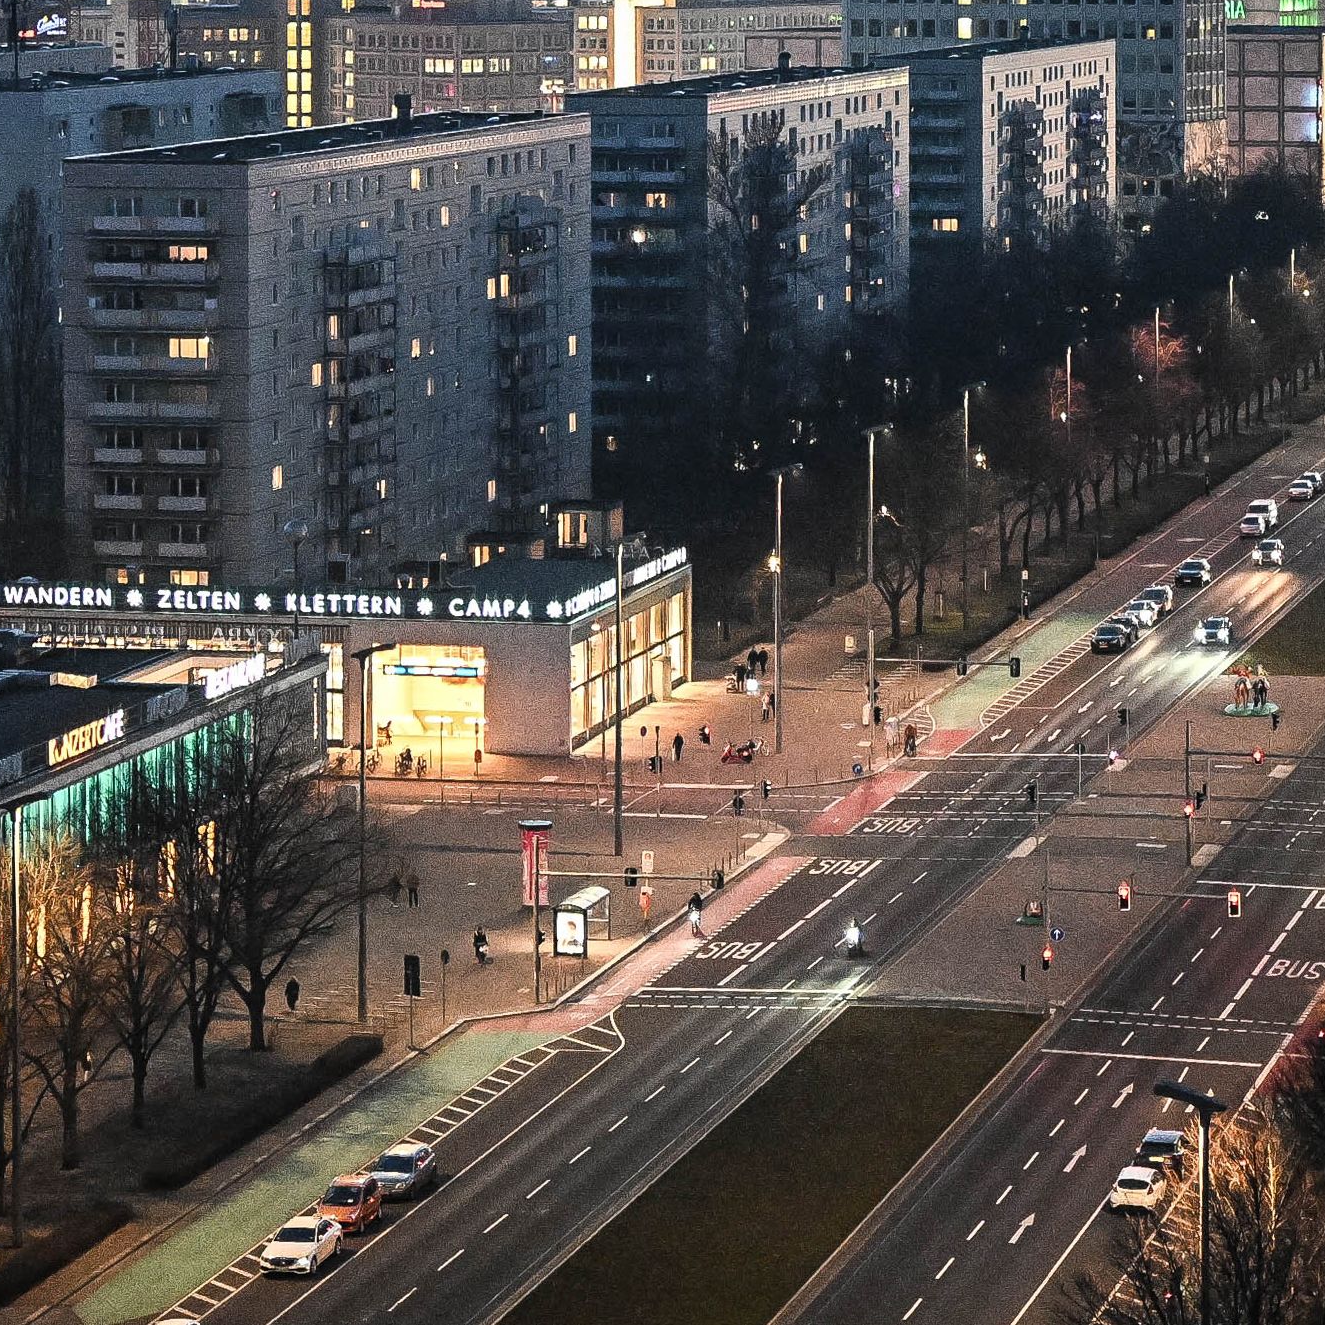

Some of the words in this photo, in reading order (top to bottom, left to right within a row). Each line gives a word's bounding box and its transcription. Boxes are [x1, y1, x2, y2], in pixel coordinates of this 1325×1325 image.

[4, 585, 112, 607] WANDERN
[157, 589, 240, 611] ZELTEN
[285, 592, 402, 616] KLETTERN
[448, 597, 531, 619] CAMP4
[862, 818, 919, 833] BUS
[809, 859, 870, 875] BUS
[695, 941, 764, 960] BUS
